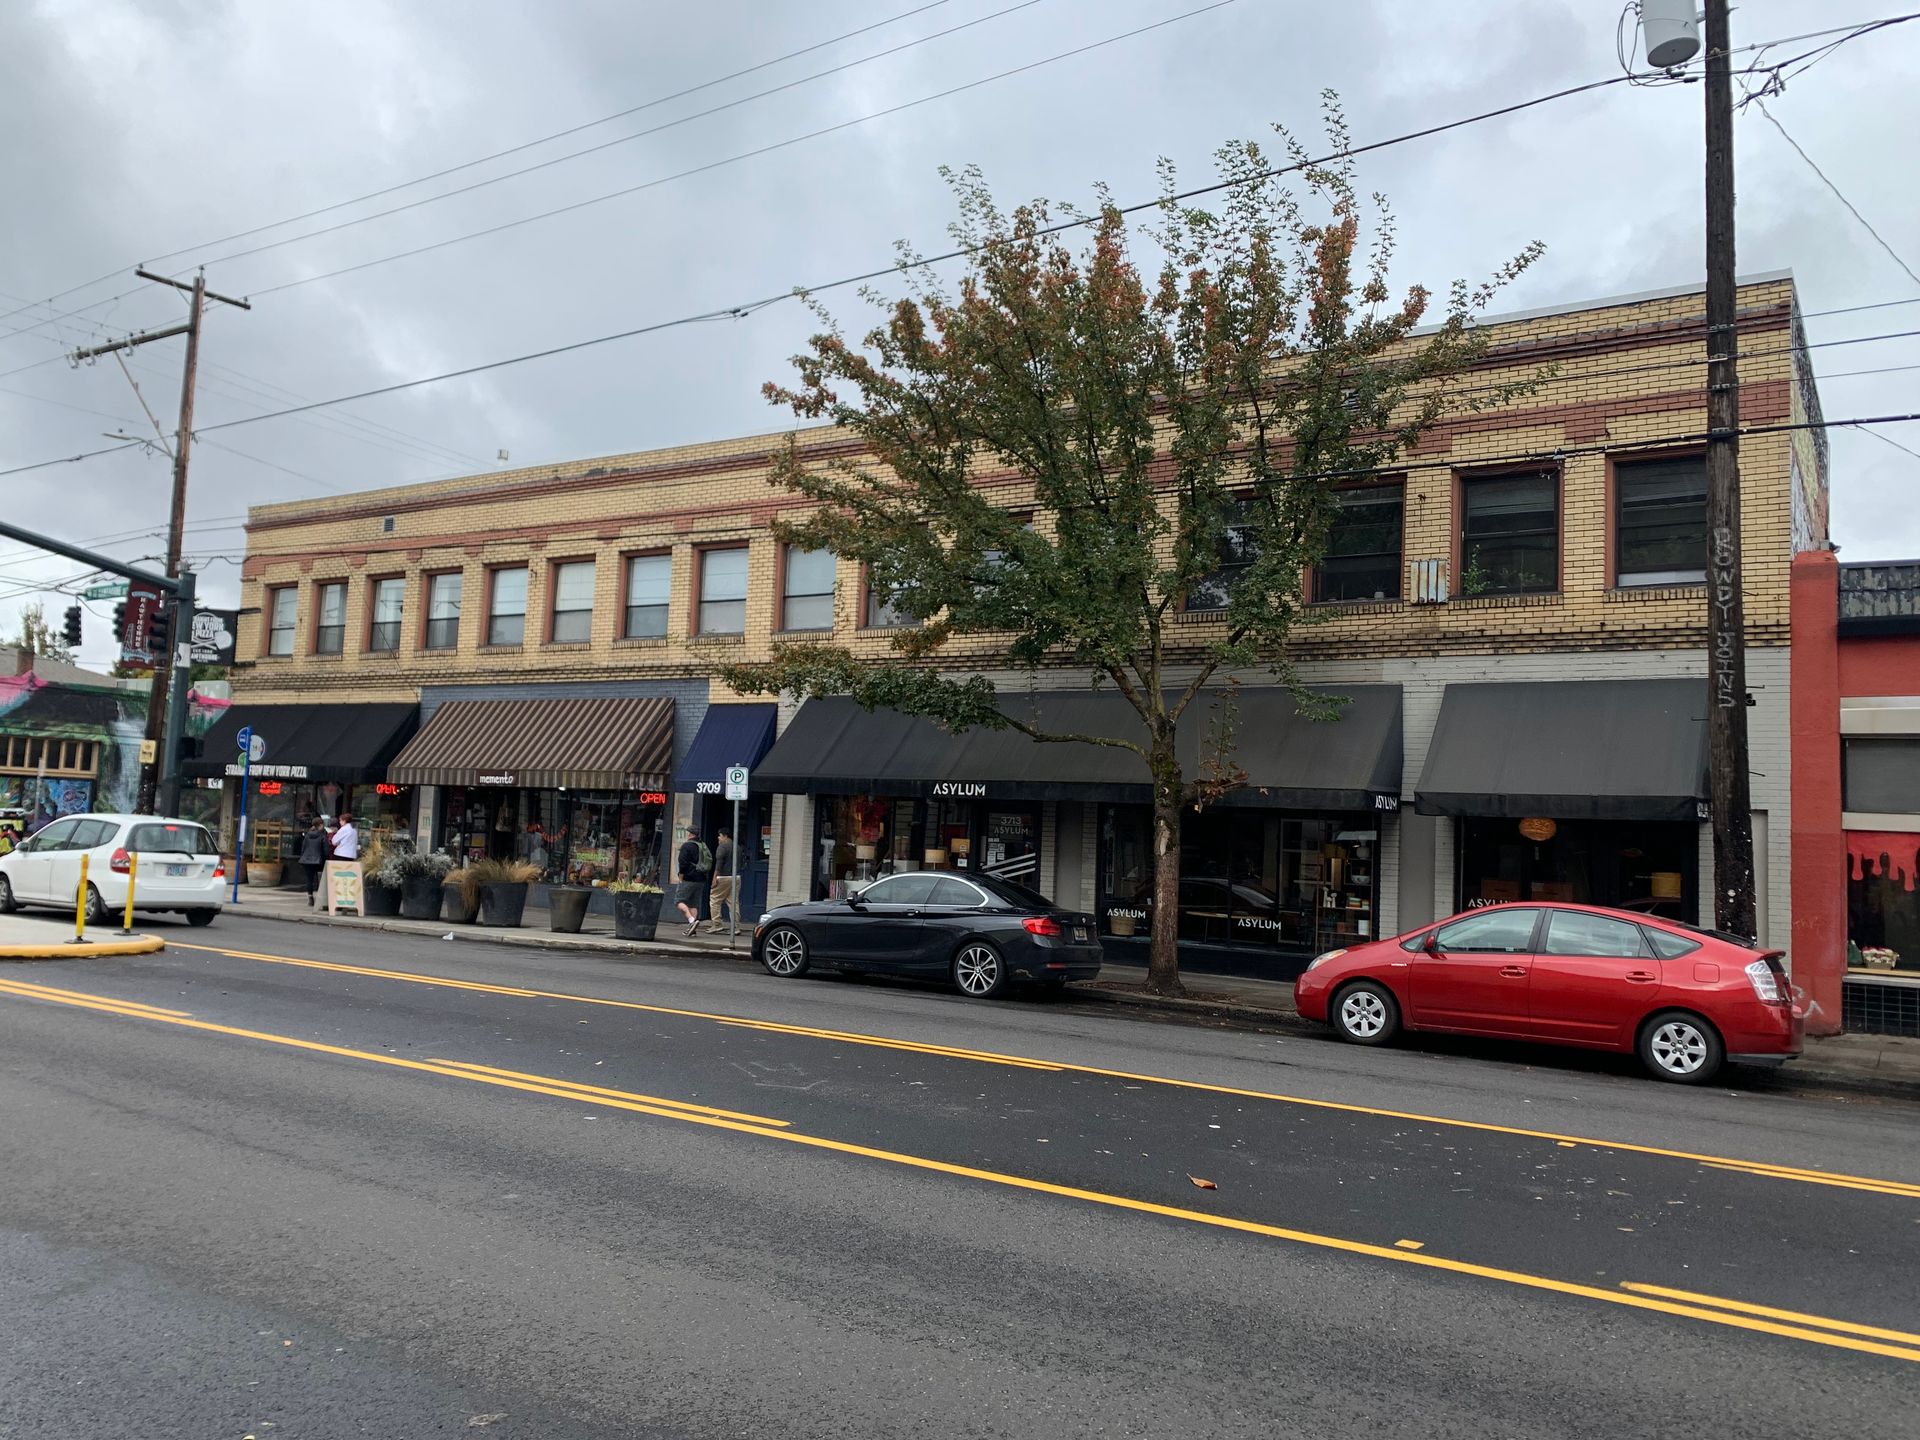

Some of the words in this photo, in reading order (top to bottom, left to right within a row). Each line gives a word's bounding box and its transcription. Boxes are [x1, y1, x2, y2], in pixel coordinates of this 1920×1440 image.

[196, 630, 214, 639] PIZZA
[249, 765, 263, 776] FROM
[263, 765, 276, 776] NEW
[276, 765, 291, 777] YORK
[290, 766, 307, 778] PIZZA
[479, 771, 514, 784] memento
[734, 772, 742, 781] P
[376, 783, 397, 795] OPEN
[696, 782, 721, 794] 3709
[933, 783, 986, 796] ASYLUM
[640, 793, 666, 805] OPEN
[1000, 816, 1022, 825] 3713
[994, 826, 1029, 835] ASYLUM
[1107, 908, 1146, 919] ASYLUM
[1237, 918, 1282, 930] ASYLUM
